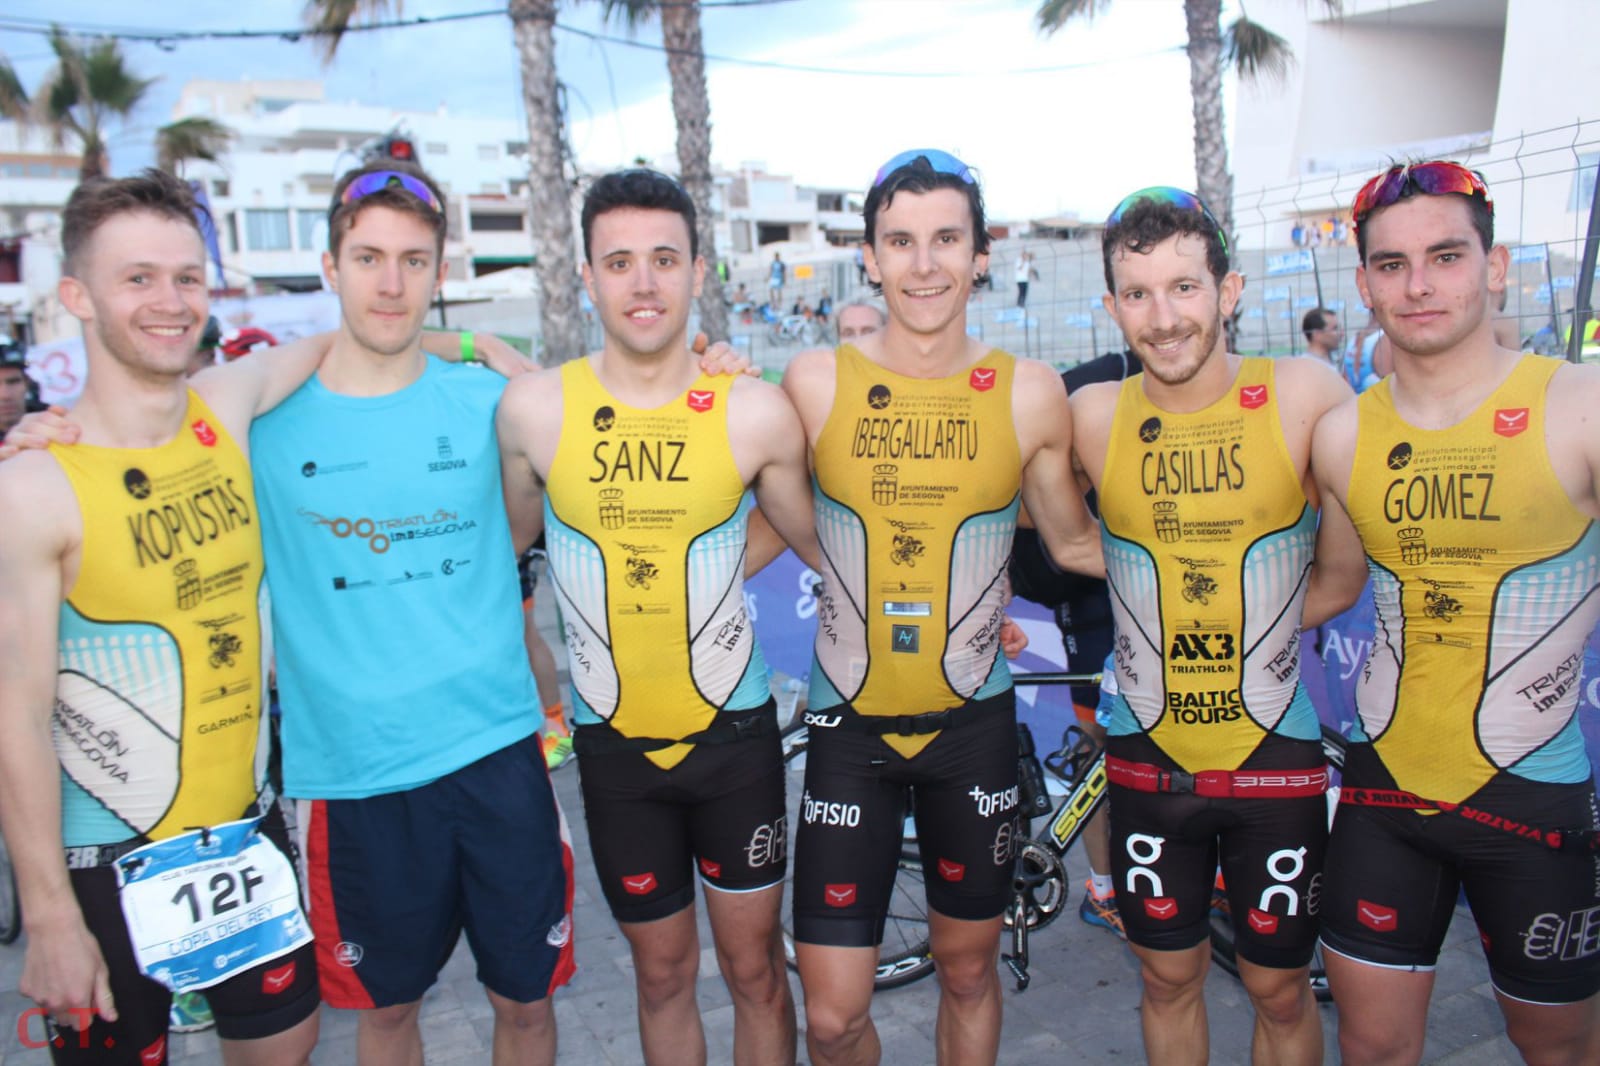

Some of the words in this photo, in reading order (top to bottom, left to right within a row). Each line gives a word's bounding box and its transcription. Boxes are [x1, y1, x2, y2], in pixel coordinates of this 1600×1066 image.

[851, 417, 978, 460] IBERGALLARTU
[428, 459, 467, 472] SEGOVIA
[589, 440, 689, 483] SANZ
[1141, 443, 1245, 495] CASILLAS
[900, 485, 959, 493] AYUNTAMIENTO
[912, 492, 945, 500] SEGOVIA
[1384, 473, 1500, 524] GOMEZ
[627, 508, 687, 516] AYUNTAMIENTO
[127, 478, 250, 568] KOPUSTAS
[1183, 518, 1245, 529] AYUNTAMIENTO
[1183, 528, 1195, 536] DE
[1196, 528, 1232, 536] SEGOVIA
[1170, 633, 1235, 661] AX3
[1170, 664, 1235, 674] TRIATHLON
[1168, 689, 1240, 707] BALTIC
[197, 711, 253, 735] GARMIN
[803, 712, 842, 728] 2XU
[1170, 705, 1242, 725] TOURS
[170, 865, 264, 924] 12F
[216, 921, 245, 941] DEL
[247, 905, 274, 925] REY
